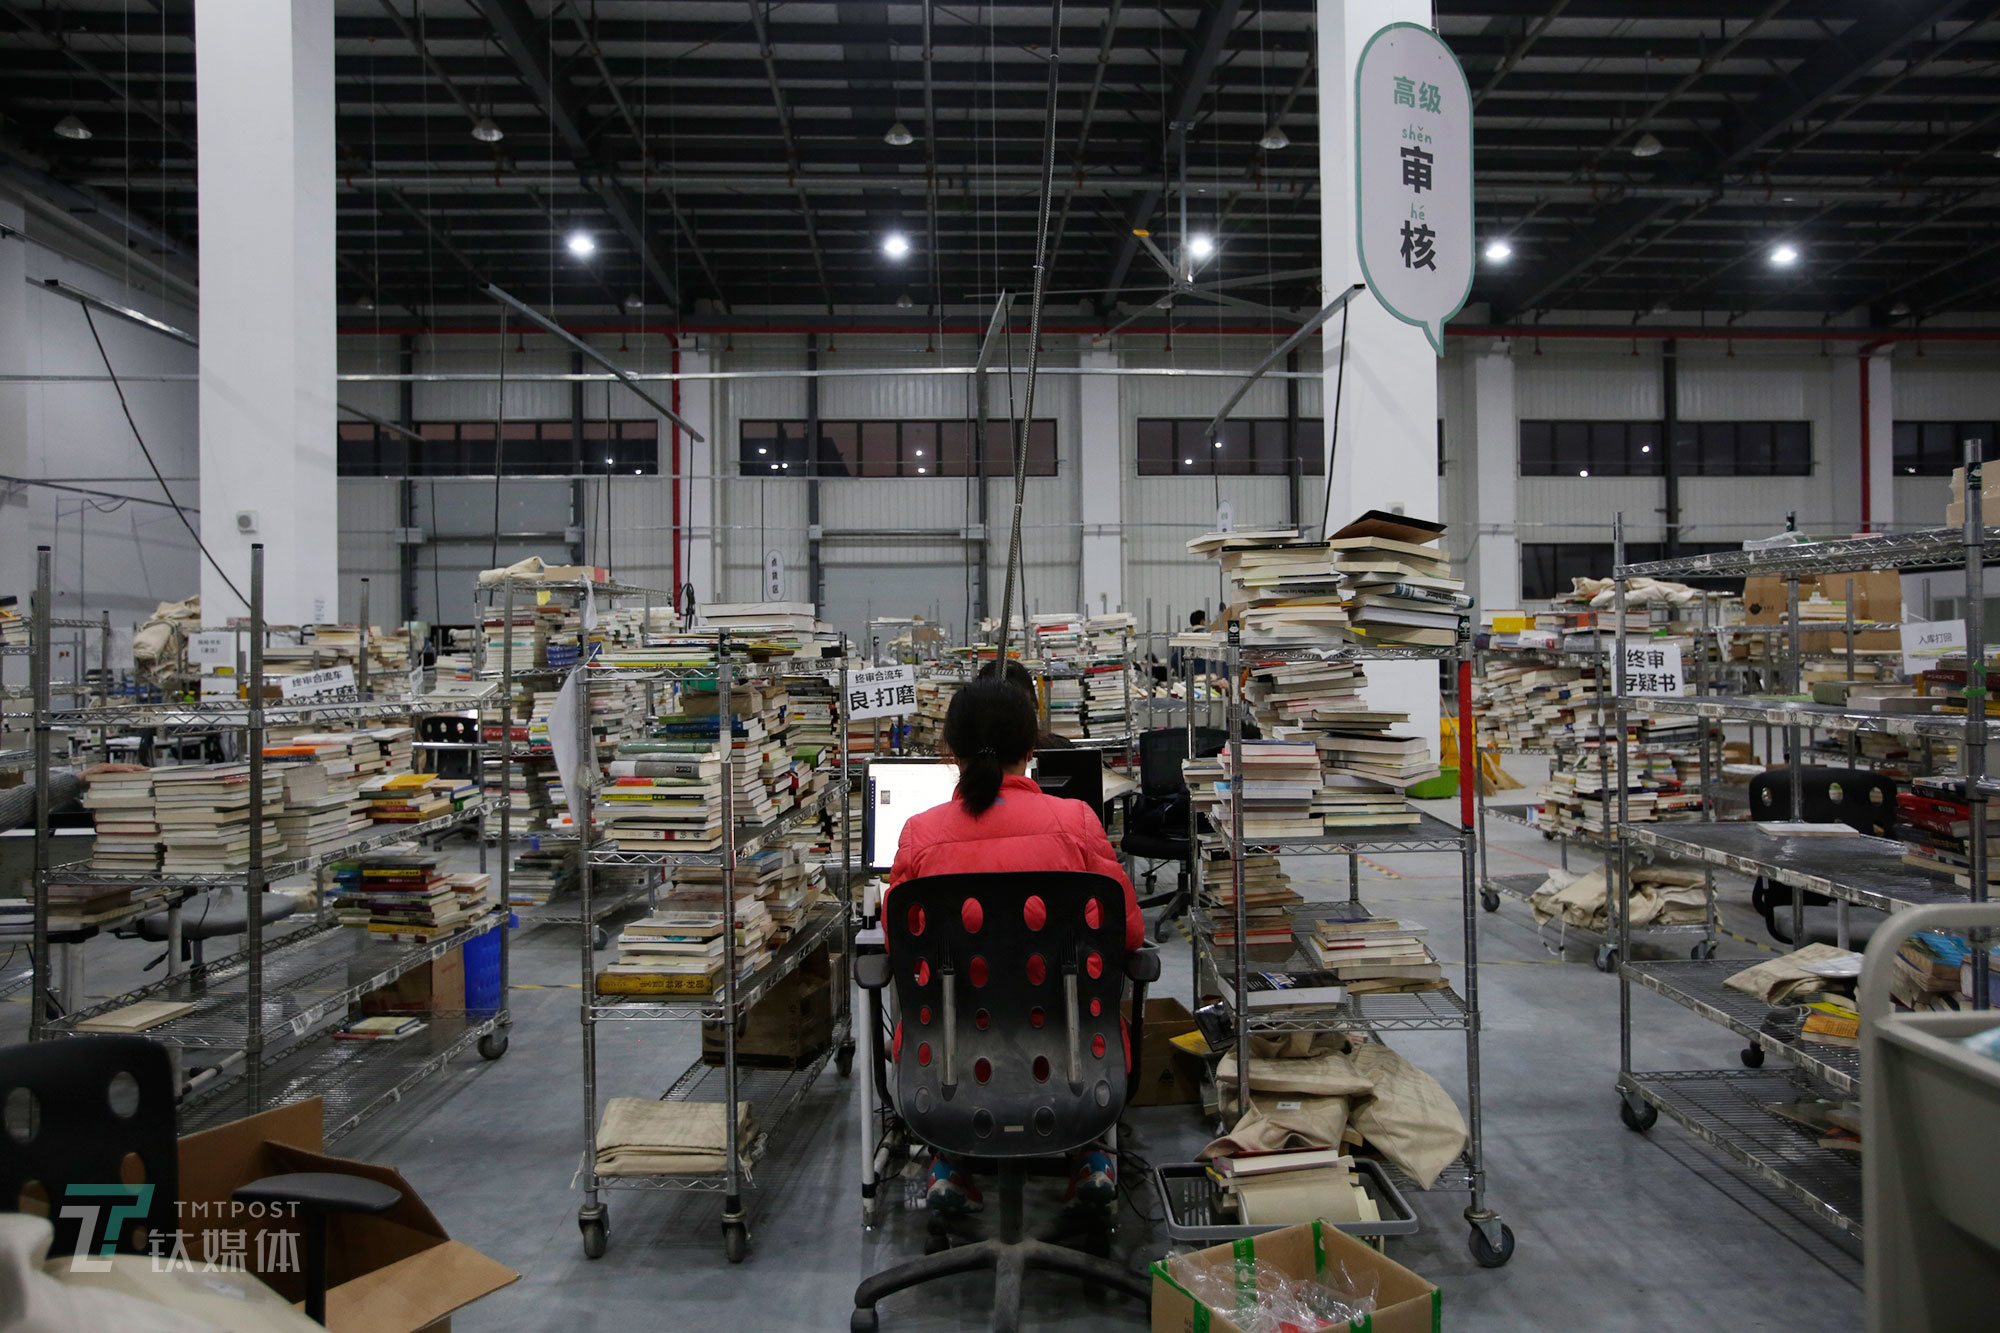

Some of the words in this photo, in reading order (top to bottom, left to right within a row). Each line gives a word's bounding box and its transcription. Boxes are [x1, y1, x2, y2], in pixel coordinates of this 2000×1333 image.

[1393, 75, 1442, 115] 高级
[1410, 202, 1425, 220] hé
[1626, 649, 1665, 669] 终审
[855, 668, 904, 684] 终审合流车
[850, 684, 915, 711] 良-打磨
